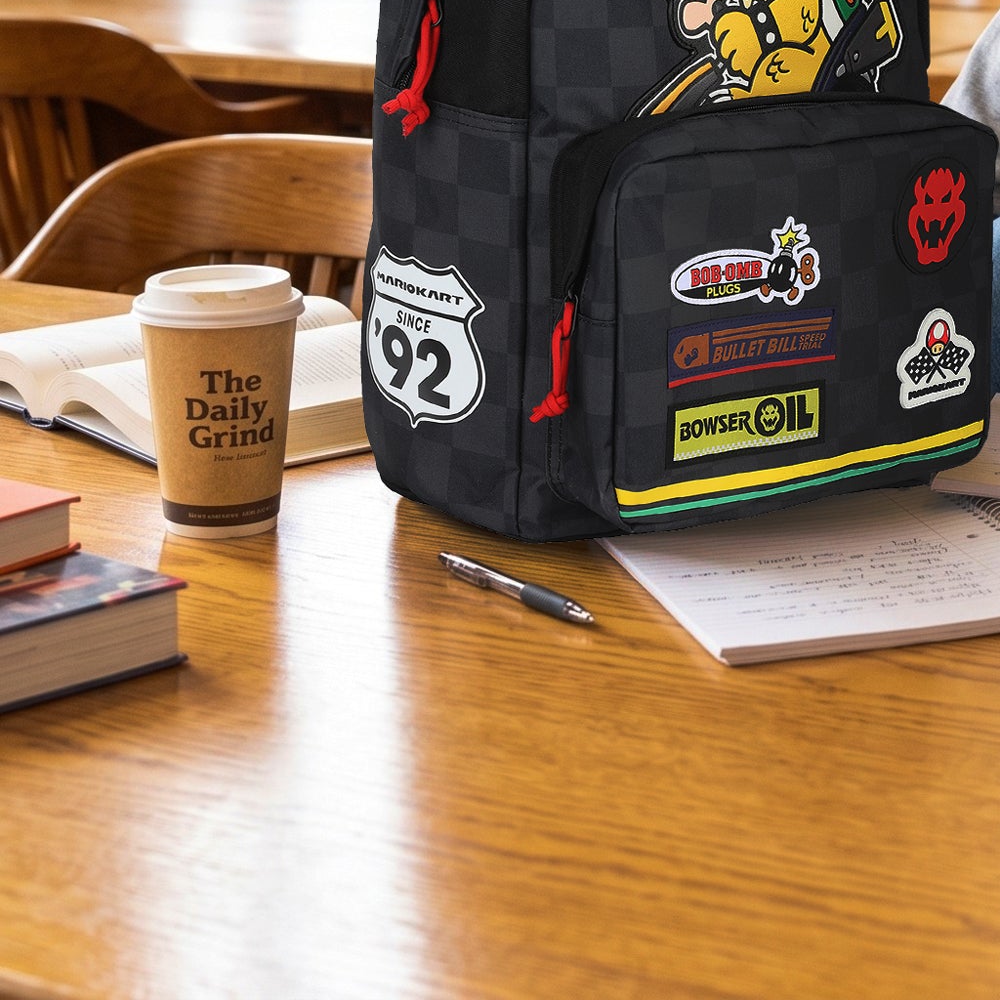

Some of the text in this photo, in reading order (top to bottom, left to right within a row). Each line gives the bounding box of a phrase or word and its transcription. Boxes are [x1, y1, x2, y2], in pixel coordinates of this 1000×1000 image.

[690, 260, 763, 287] BOB-OMB
[376, 271, 464, 306] MARIOKART
[706, 283, 741, 298] PLUGS
[396, 310, 431, 334] SINCE
[712, 336, 798, 364] BULLET BILL
[799, 341, 822, 351] TRIAL
[800, 332, 827, 342] SPEED
[374, 317, 451, 410] '92
[200, 369, 262, 394] The
[185, 395, 268, 425] Daily
[680, 394, 814, 442] BOWSER OIL
[189, 417, 275, 449] Grind
